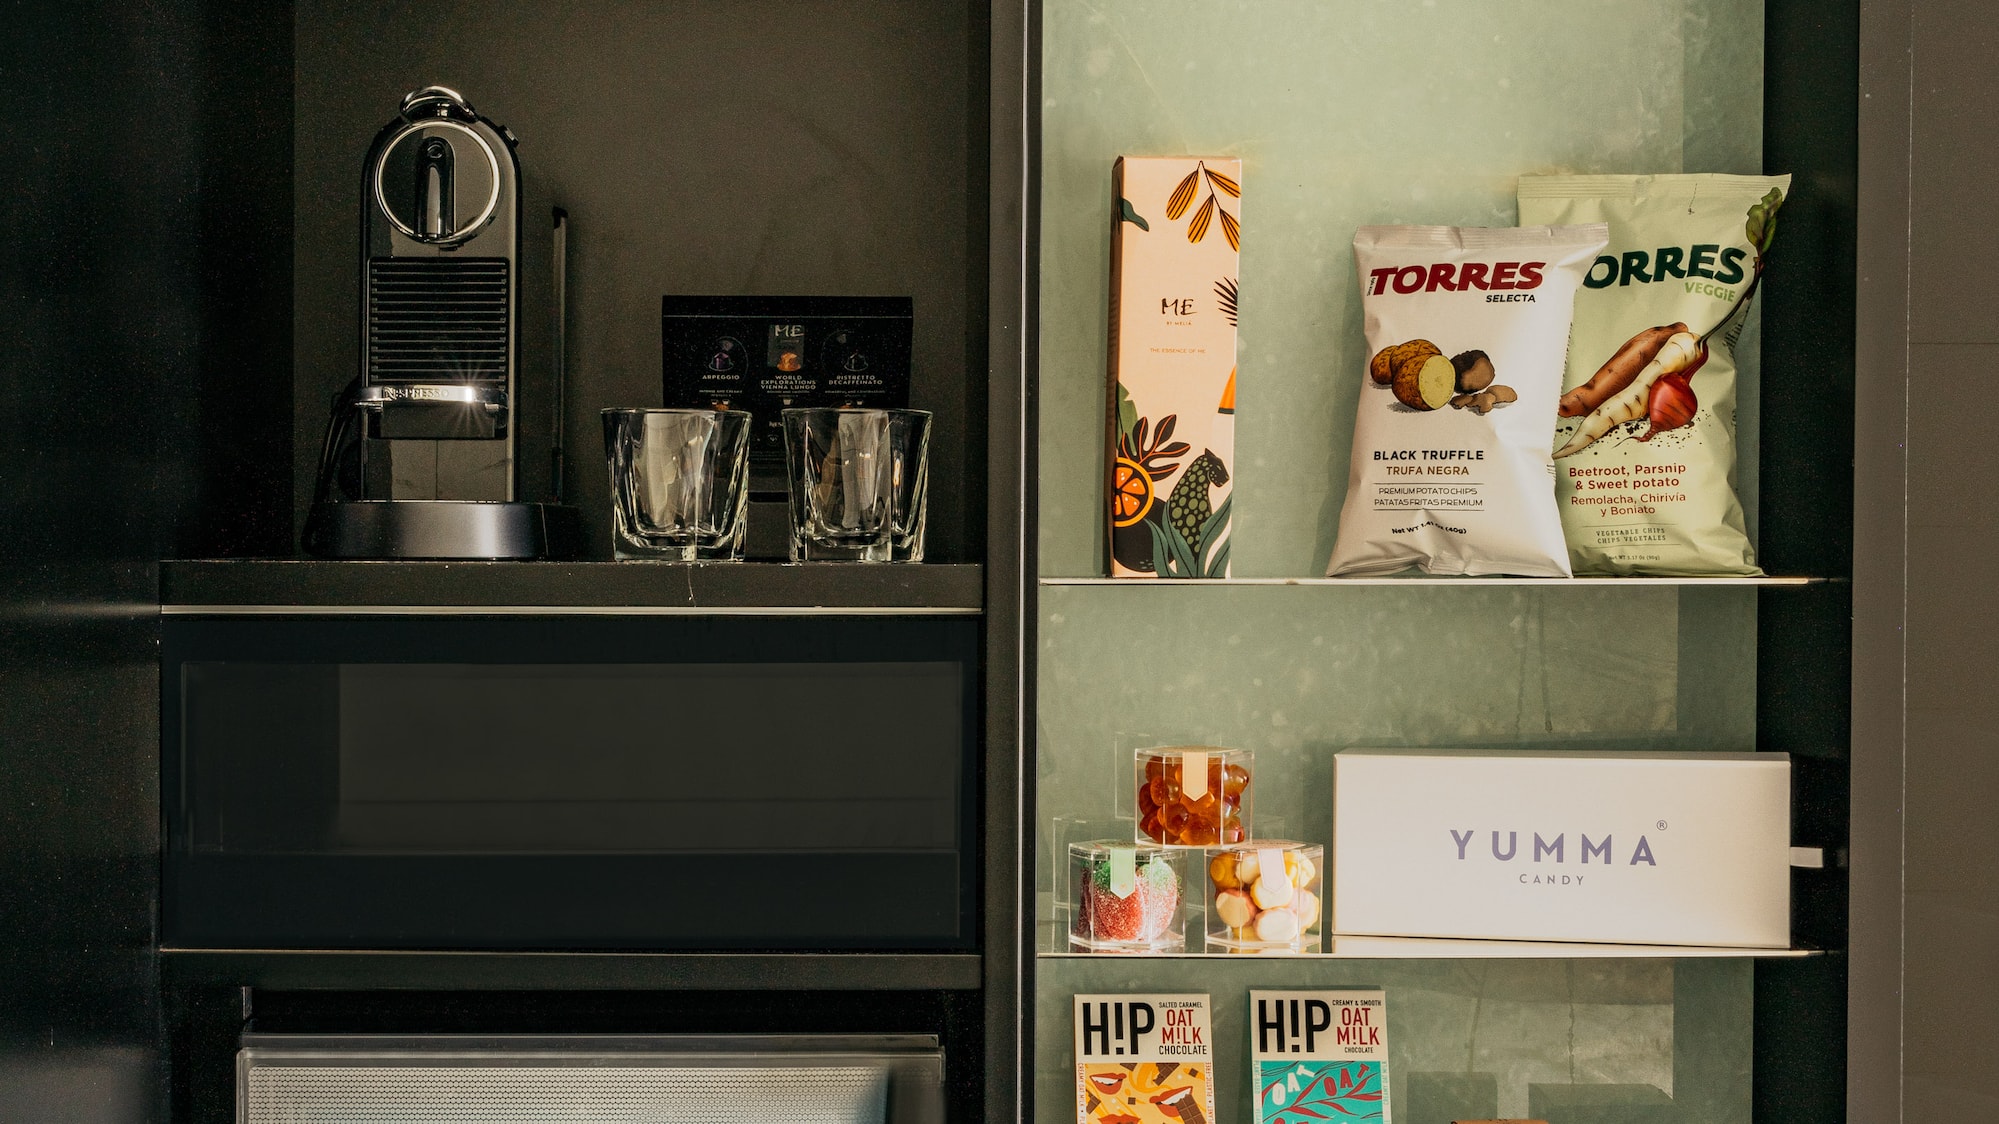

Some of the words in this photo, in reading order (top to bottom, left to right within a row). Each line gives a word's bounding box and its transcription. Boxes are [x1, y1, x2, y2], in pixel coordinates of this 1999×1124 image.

[1582, 244, 1748, 289] ORRES
[1369, 261, 1547, 296] TORRES
[1485, 293, 1536, 303] SELECTA
[1161, 297, 1198, 316] ME
[774, 324, 805, 337] ME
[1373, 450, 1417, 461] BLACK
[1421, 450, 1485, 460] TRUFFLE
[1386, 466, 1423, 475] TRUFA
[1427, 466, 1470, 475] NEGRA
[1569, 465, 1630, 477] Beetroot,
[1634, 462, 1687, 475] Parsnip
[1378, 487, 1415, 495] PREMIUM
[1416, 487, 1450, 495] POTATO
[1575, 480, 1584, 491] &
[1588, 479, 1628, 490] Sweet
[1633, 477, 1680, 490] potato
[1571, 494, 1637, 506] Remolacha,
[1640, 492, 1687, 504] Chirivía
[1600, 508, 1607, 518] y
[1610, 504, 1656, 516] Boniato
[1406, 525, 1419, 534] WT
[1445, 526, 1467, 535] (40g)
[1597, 536, 1621, 544] CHIPS
[1450, 829, 1657, 866] YUMMA
[1519, 873, 1584, 886] CANDY
[1158, 1001, 1178, 1009] SALTED
[1178, 1001, 1203, 1009] CARAMEL
[1332, 999, 1354, 1007] CREAMY
[1166, 1009, 1194, 1027] OAT
[1341, 1007, 1371, 1026] OAT
[1082, 1002, 1155, 1056] H!P
[1258, 999, 1331, 1053] H!P
[1162, 1026, 1203, 1045] M!LK
[1336, 1026, 1380, 1046] M!LK
[1158, 1045, 1208, 1055] CHOCOLATE
[1344, 1046, 1374, 1054] CHOCOLATE
[1272, 1064, 1316, 1106] OAT
[1323, 1063, 1370, 1097] OAT
